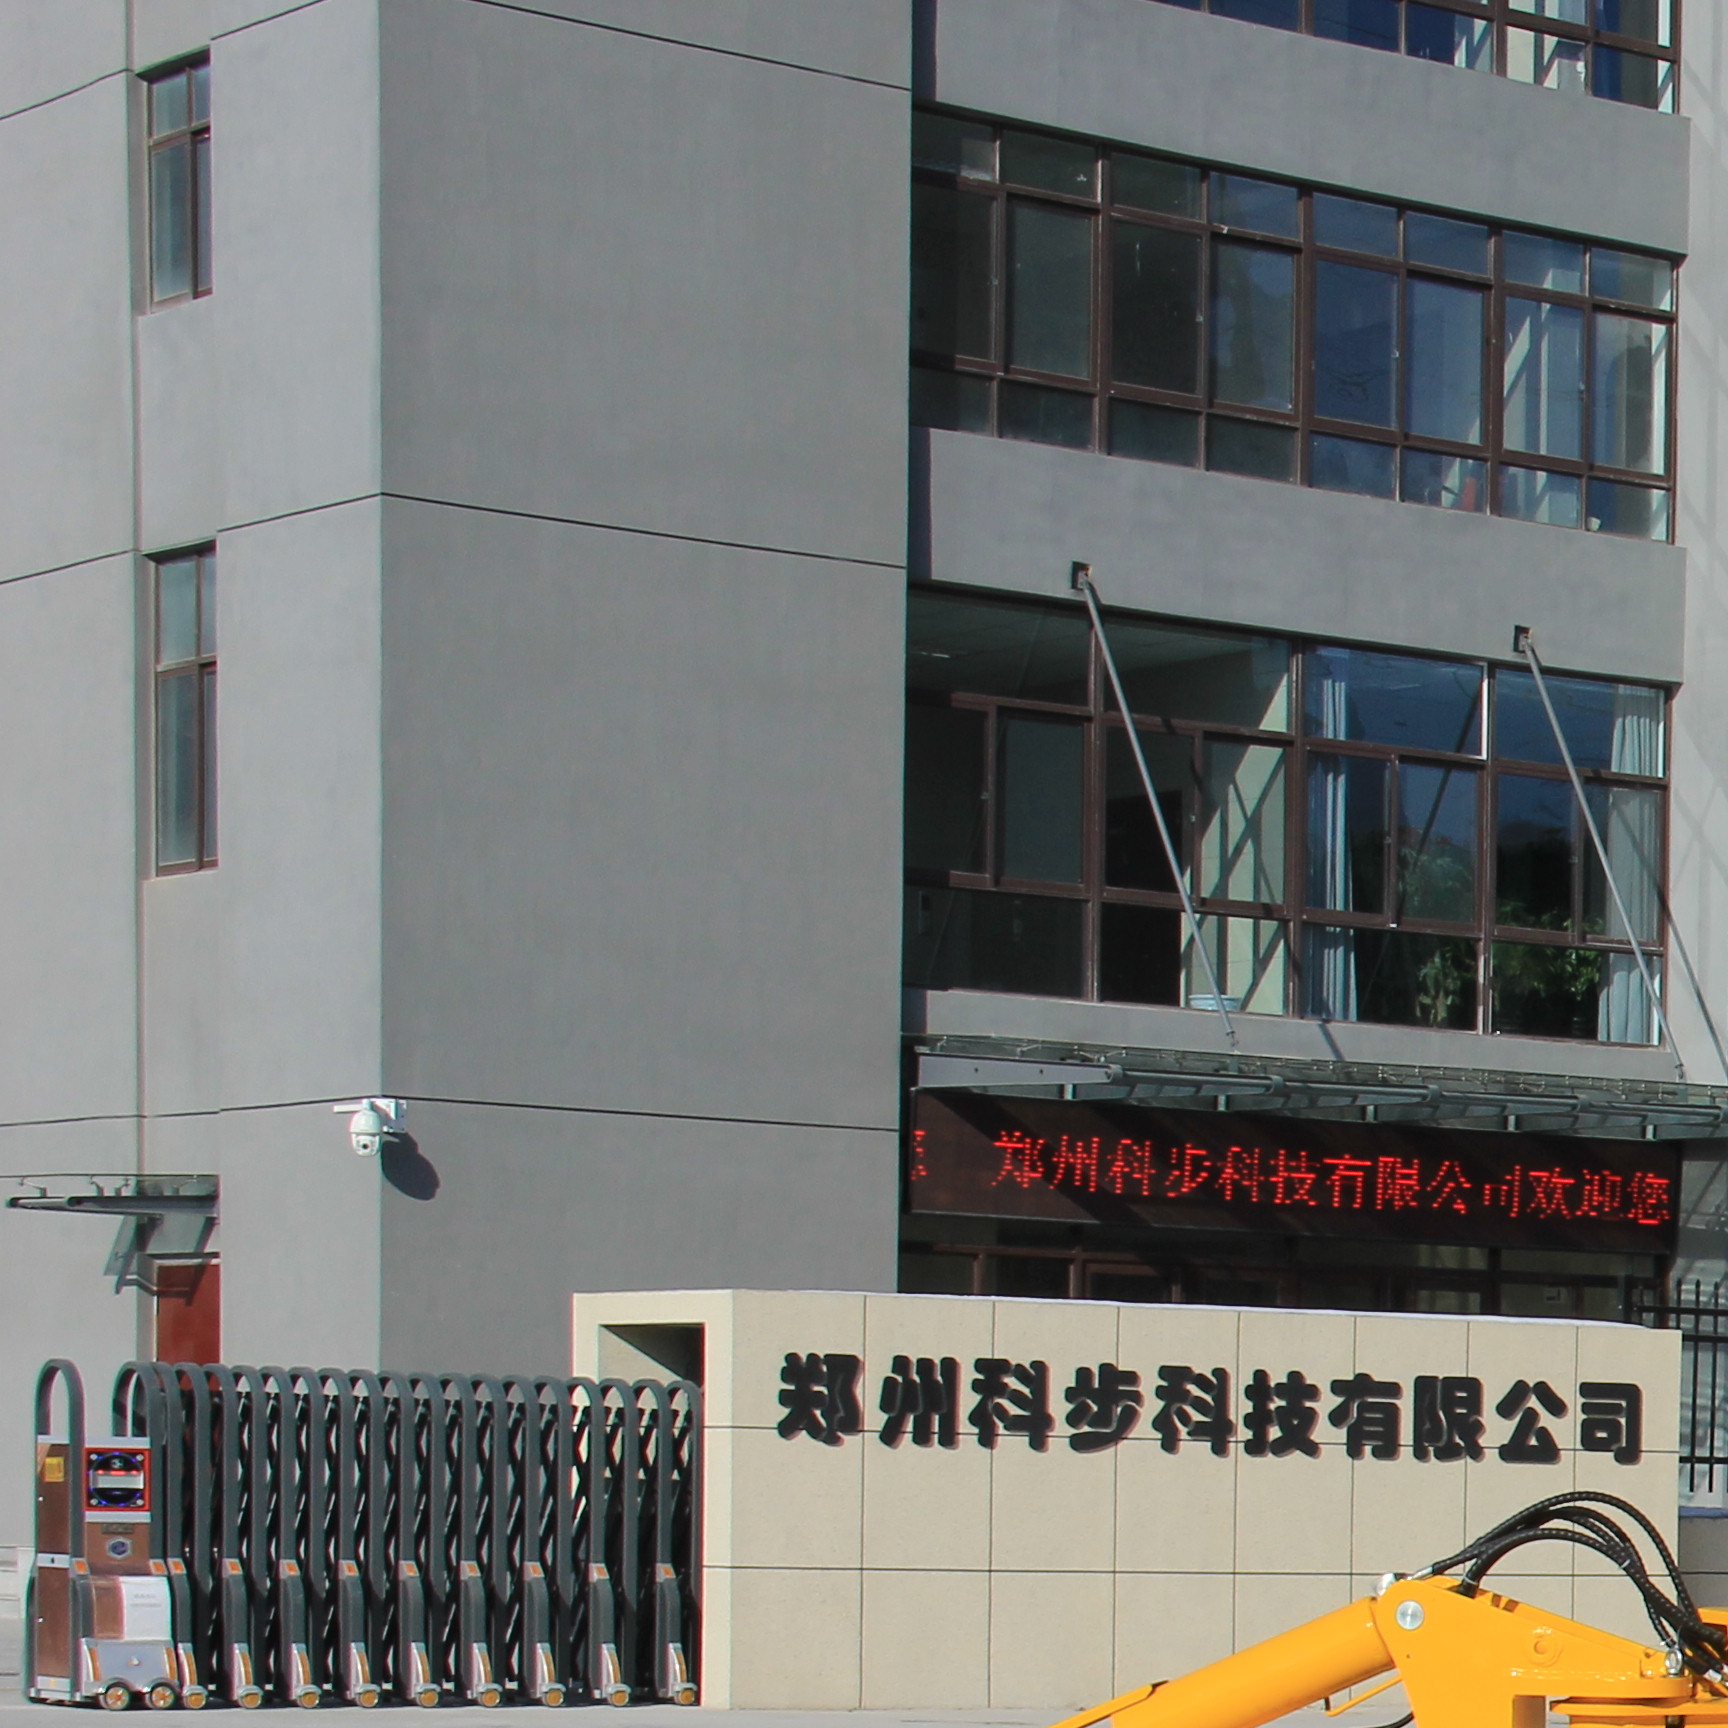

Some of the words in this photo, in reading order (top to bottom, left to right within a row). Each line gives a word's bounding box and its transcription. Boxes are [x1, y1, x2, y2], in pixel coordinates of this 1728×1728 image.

[775, 1352, 1642, 1465] 郑州科步科技有限公司
